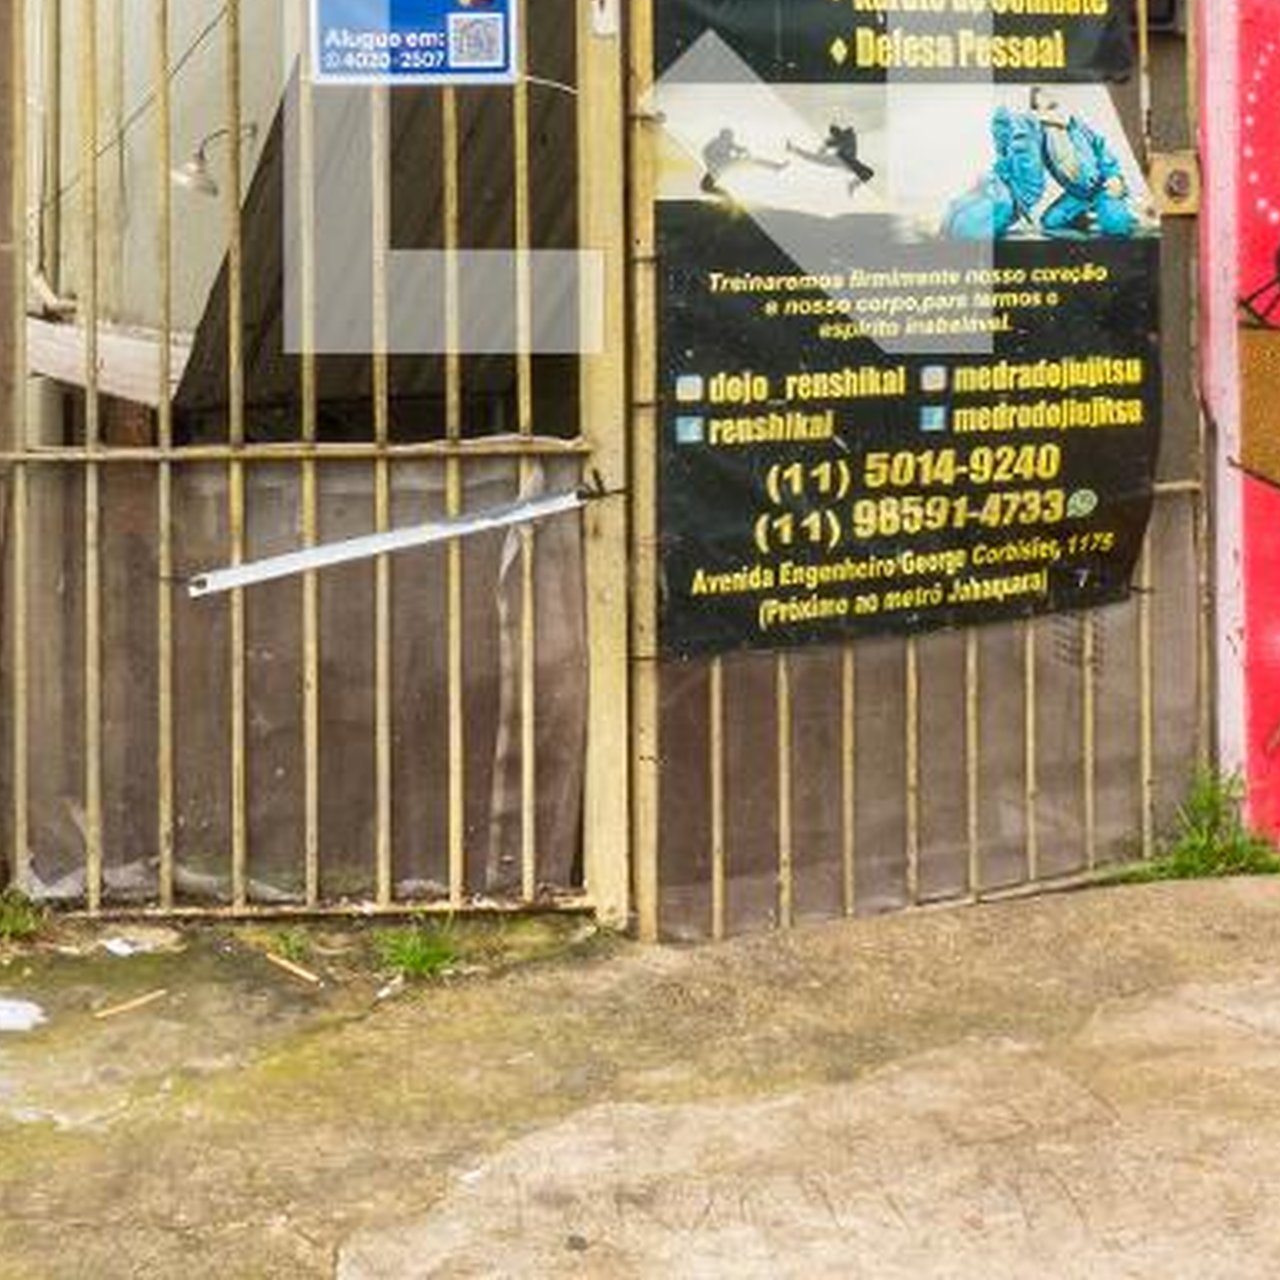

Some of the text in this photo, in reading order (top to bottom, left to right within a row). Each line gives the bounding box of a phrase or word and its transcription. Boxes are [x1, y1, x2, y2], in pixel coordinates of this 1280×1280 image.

[855, 26, 1067, 69] Defesa Pessoal
[965, 267, 1027, 286] nosso
[783, 297, 852, 315] nosso
[708, 409, 835, 445] renshikai
[766, 442, 1062, 505] (11) 5014-9240
[754, 489, 1066, 554] (11) 98591-4733
[691, 562, 775, 596] Avenida
[779, 554, 896, 590] Engenheiro
[901, 549, 968, 576] George
[853, 593, 880, 614] ao
